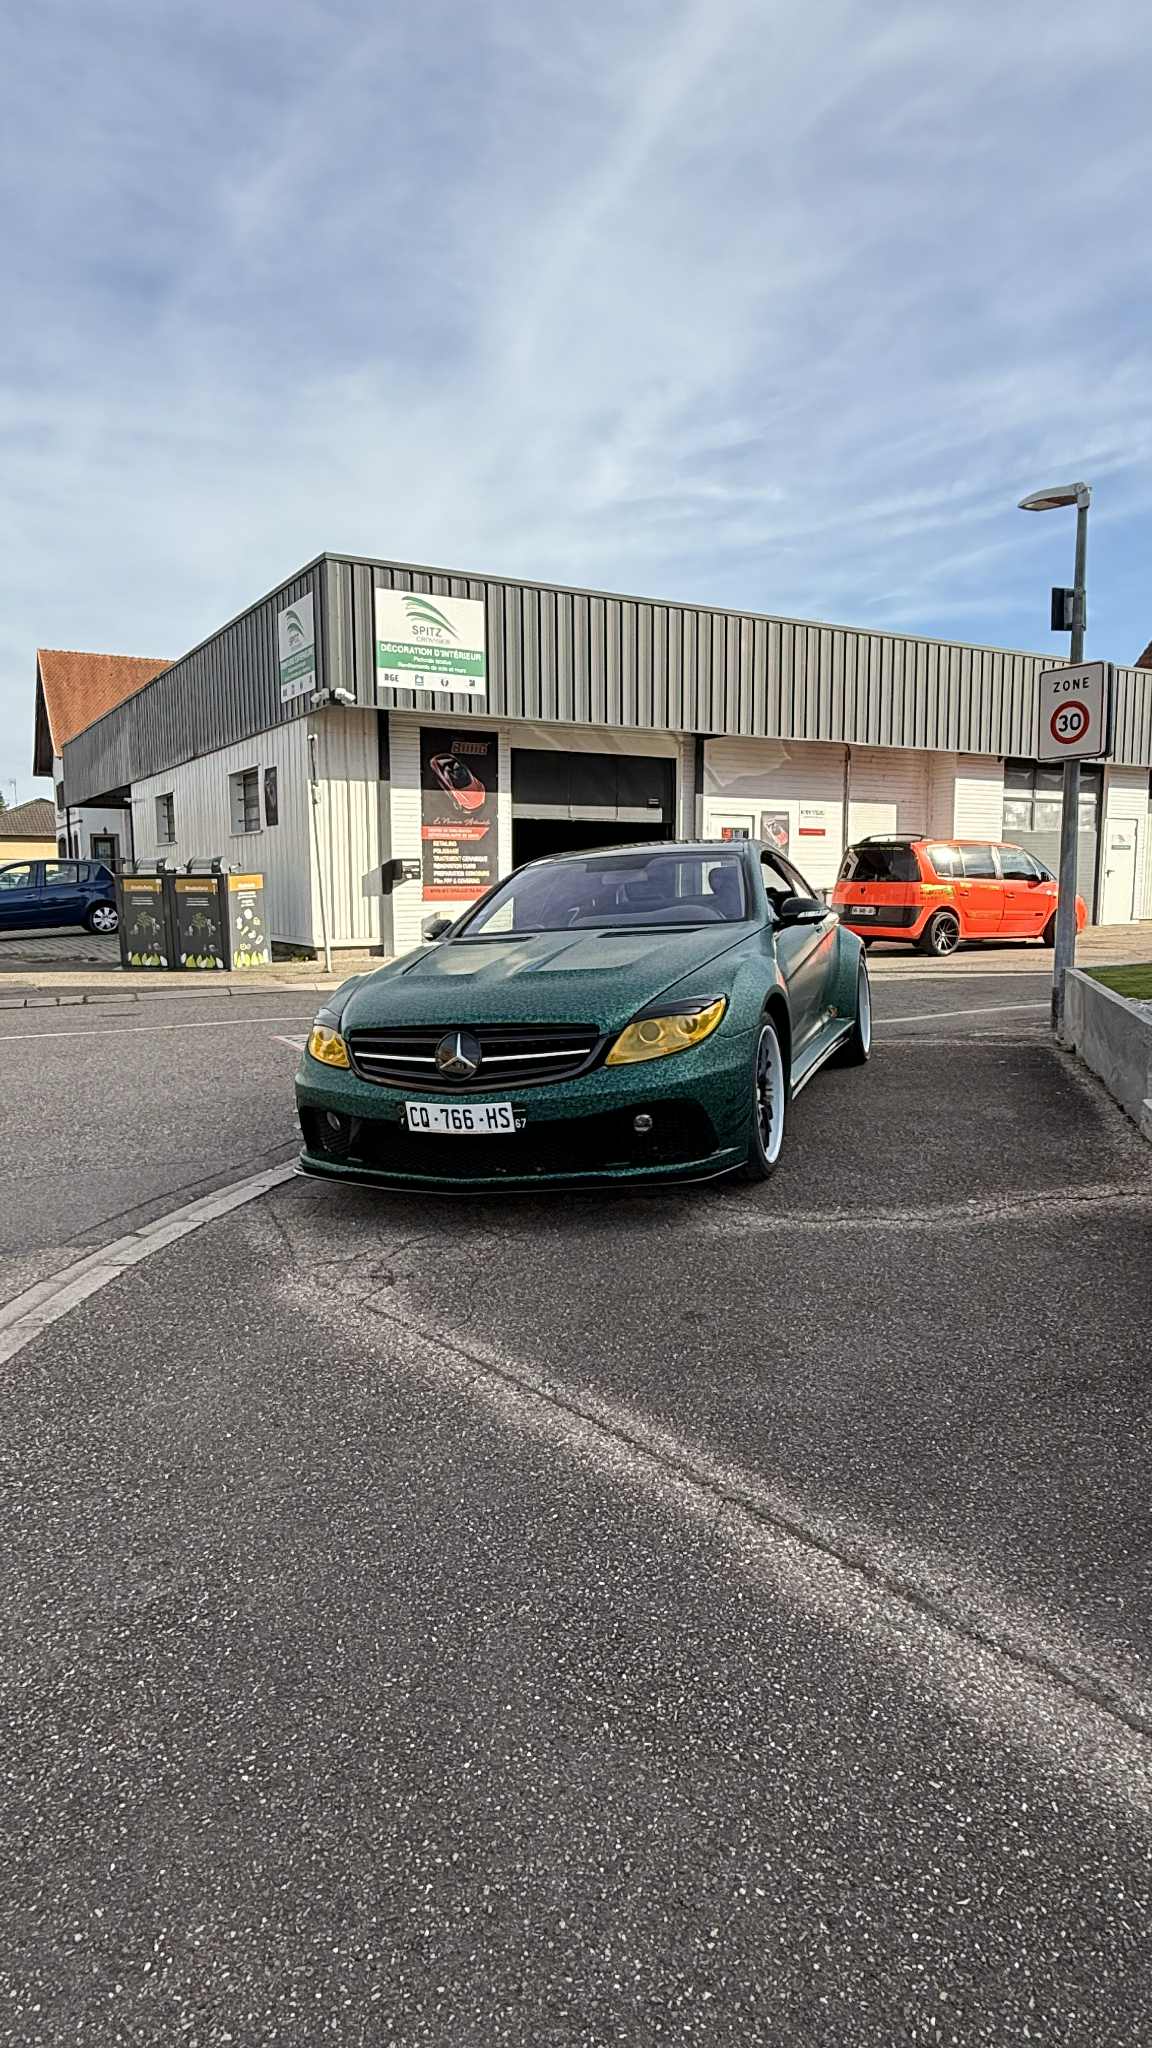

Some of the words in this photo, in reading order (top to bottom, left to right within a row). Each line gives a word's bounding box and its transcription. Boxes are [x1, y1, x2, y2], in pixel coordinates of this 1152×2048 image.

[412, 625, 442, 637] SPITZ
[380, 643, 433, 656] DÉCORATION
[434, 650, 481, 661] D'INTÉRIEUR
[1053, 677, 1090, 693] ZONE
[1058, 713, 1081, 732] 30
[514, 1117, 527, 1129] 67
